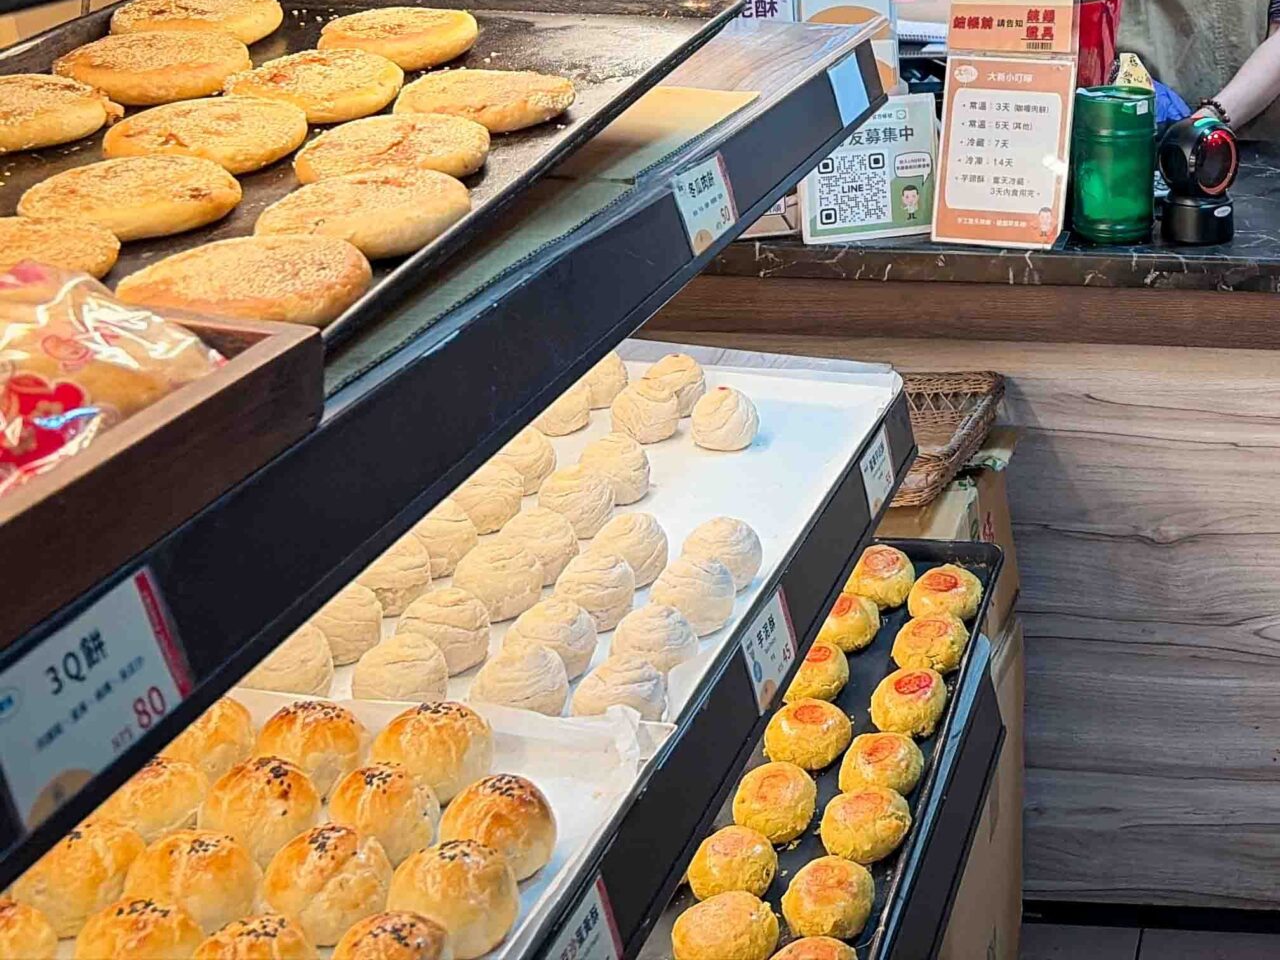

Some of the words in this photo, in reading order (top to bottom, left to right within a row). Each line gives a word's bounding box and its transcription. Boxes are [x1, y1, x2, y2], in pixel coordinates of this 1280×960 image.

[840, 125, 914, 147] 友募集中
[842, 183, 864, 194] LINE
[45, 627, 109, 697] 3Q餅
[132, 685, 167, 730] 80
